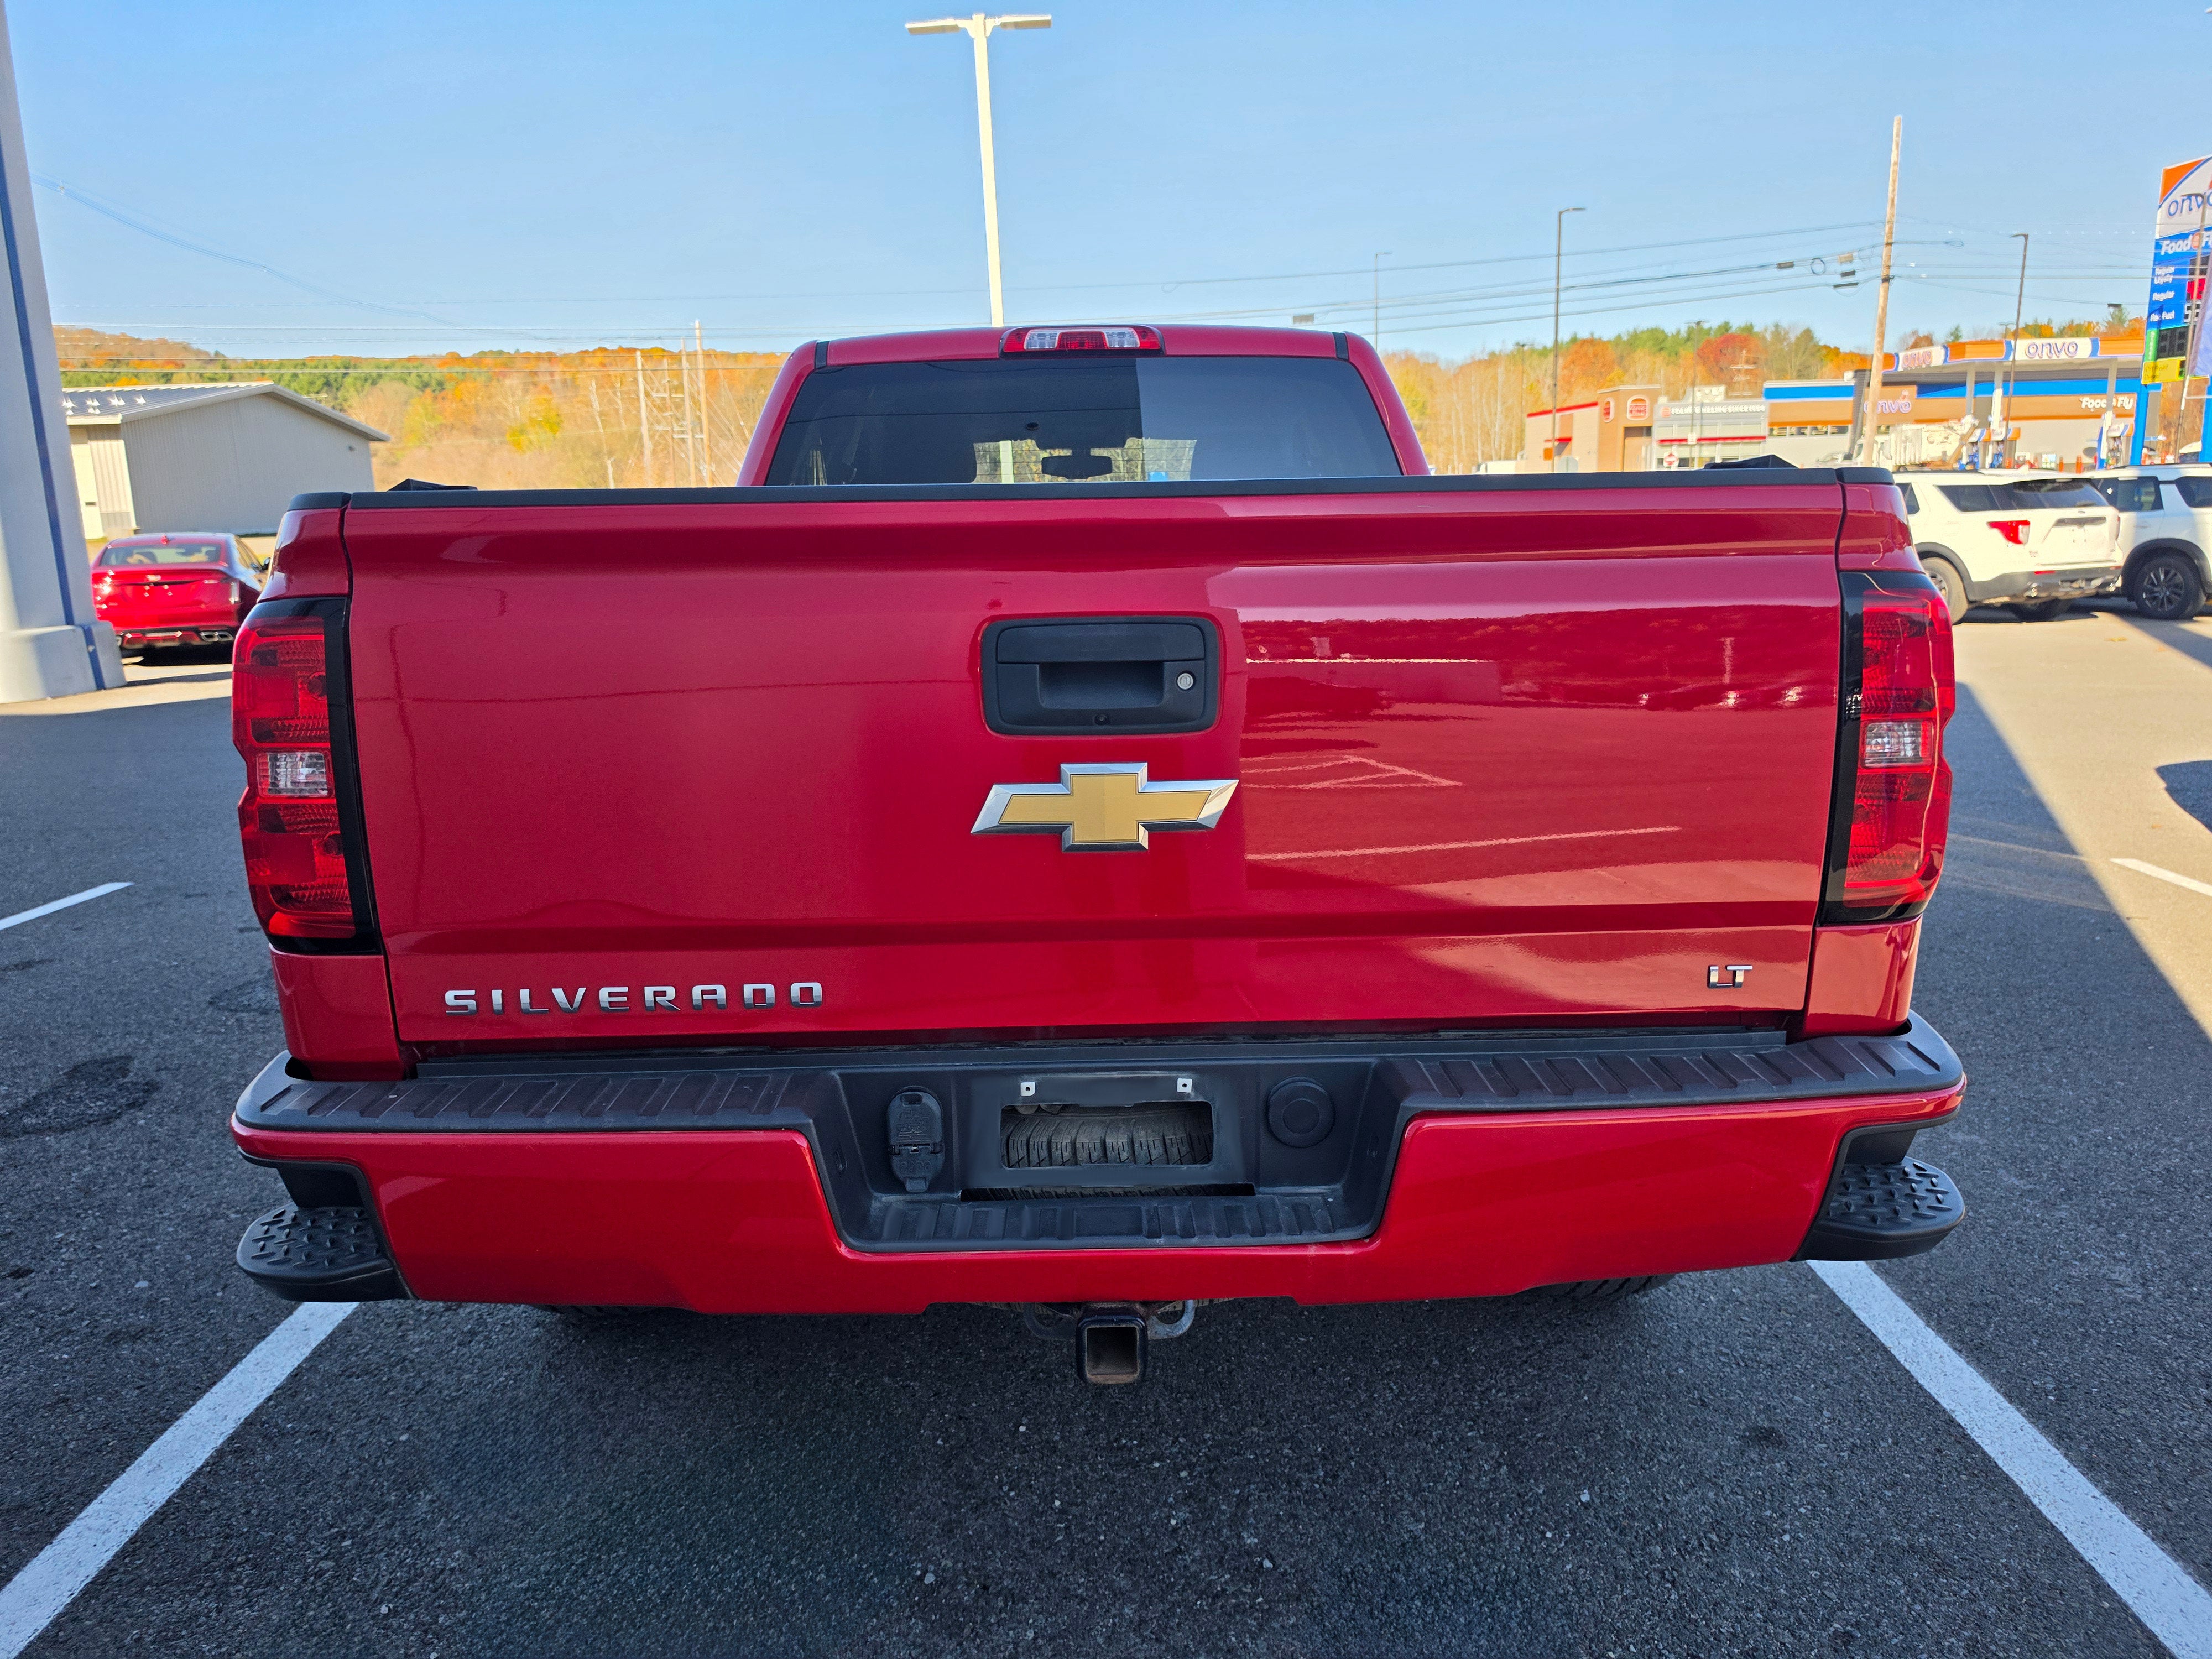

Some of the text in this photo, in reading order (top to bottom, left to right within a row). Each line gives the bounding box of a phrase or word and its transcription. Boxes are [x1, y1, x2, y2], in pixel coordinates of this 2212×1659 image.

[2161, 234, 2193, 255] Food
[1902, 350, 1932, 368] onvo
[2025, 341, 2078, 359] onvo
[2117, 396, 2133, 410] Fly
[1707, 966, 1753, 988] LT
[445, 982, 822, 1015] SILVERADO
